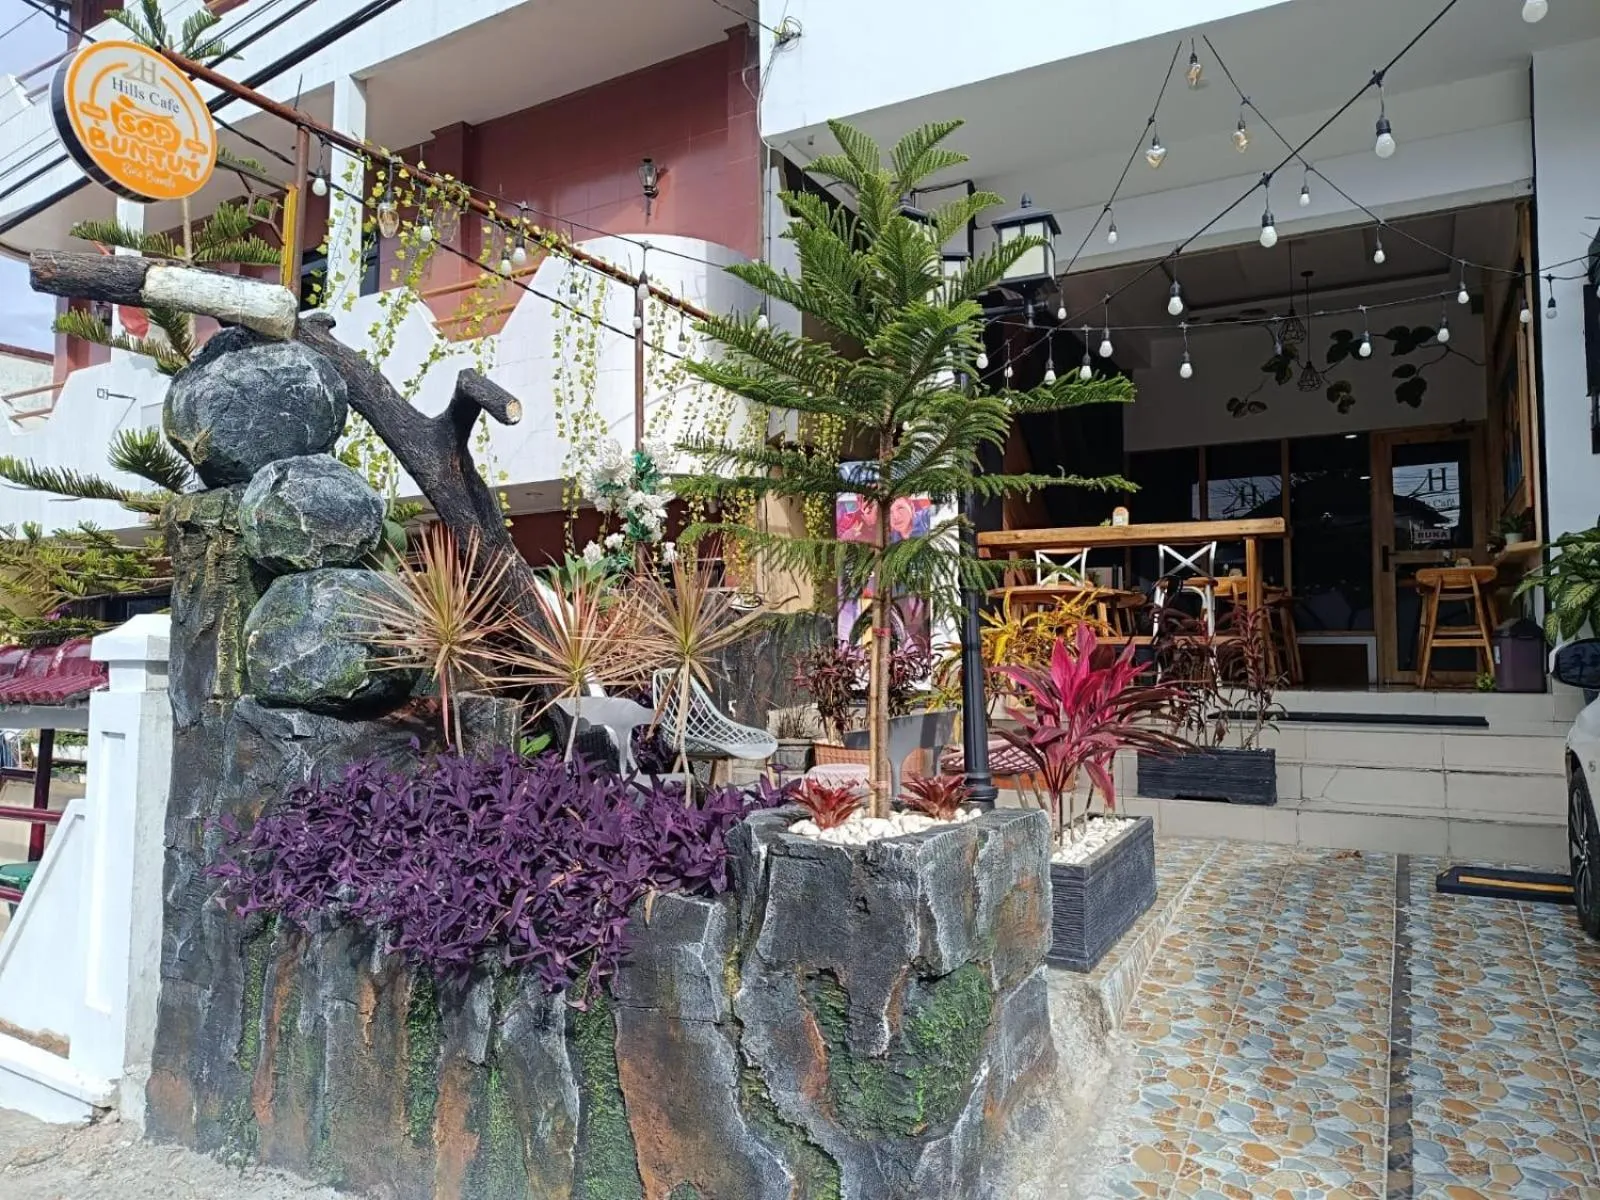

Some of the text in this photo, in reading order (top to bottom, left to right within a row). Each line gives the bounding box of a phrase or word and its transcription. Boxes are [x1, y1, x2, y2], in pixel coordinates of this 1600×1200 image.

[112, 76, 145, 101] Hills
[119, 112, 174, 145] SOP
[87, 126, 200, 181] BUNTUT
[1428, 467, 1448, 491] H
